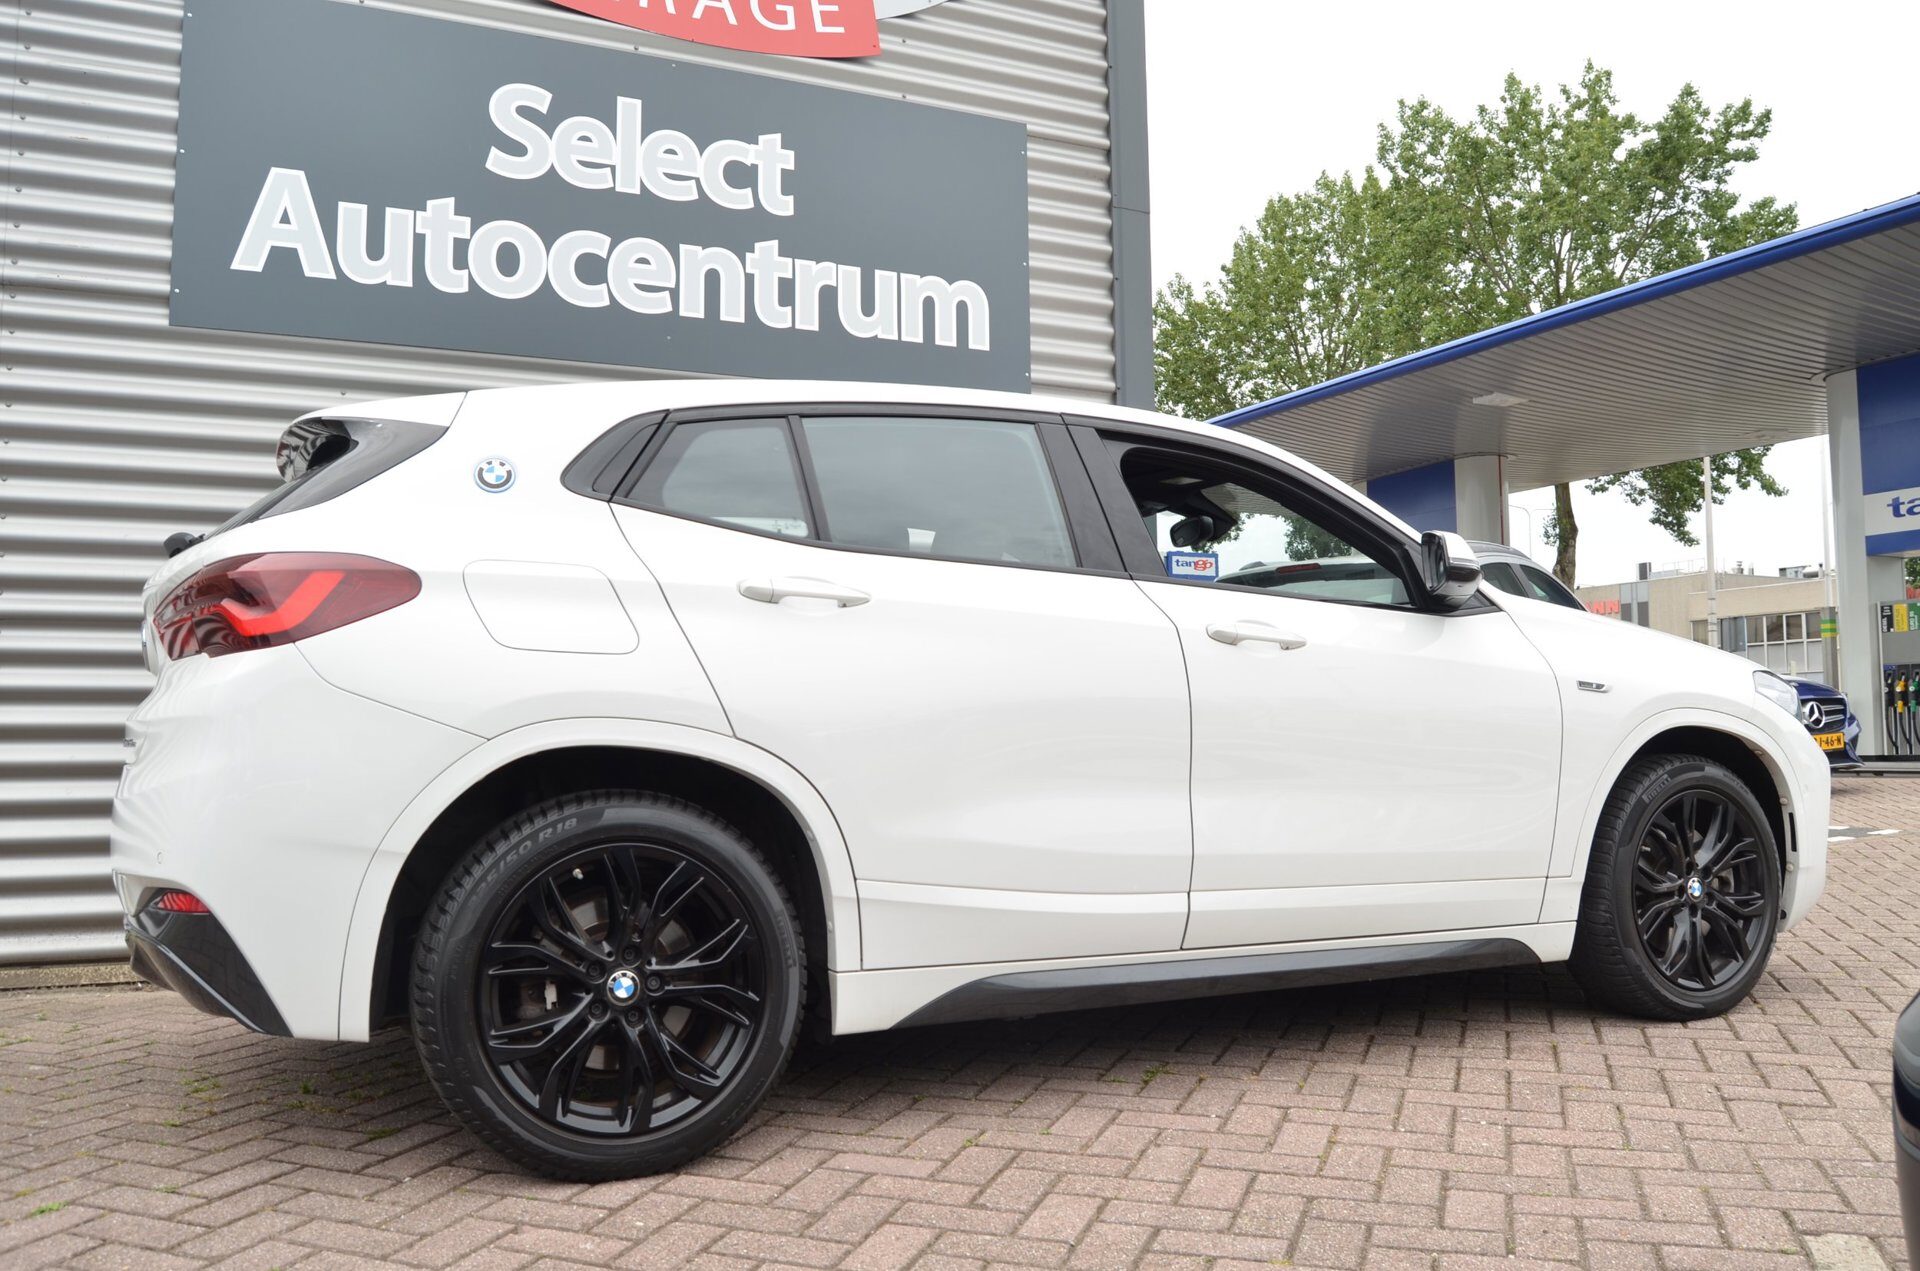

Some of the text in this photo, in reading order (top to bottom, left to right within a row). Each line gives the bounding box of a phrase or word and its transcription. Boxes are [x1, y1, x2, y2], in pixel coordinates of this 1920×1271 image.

[484, 82, 796, 217] Select
[230, 166, 991, 351] Autocentrum
[1174, 558, 1213, 571] tango
